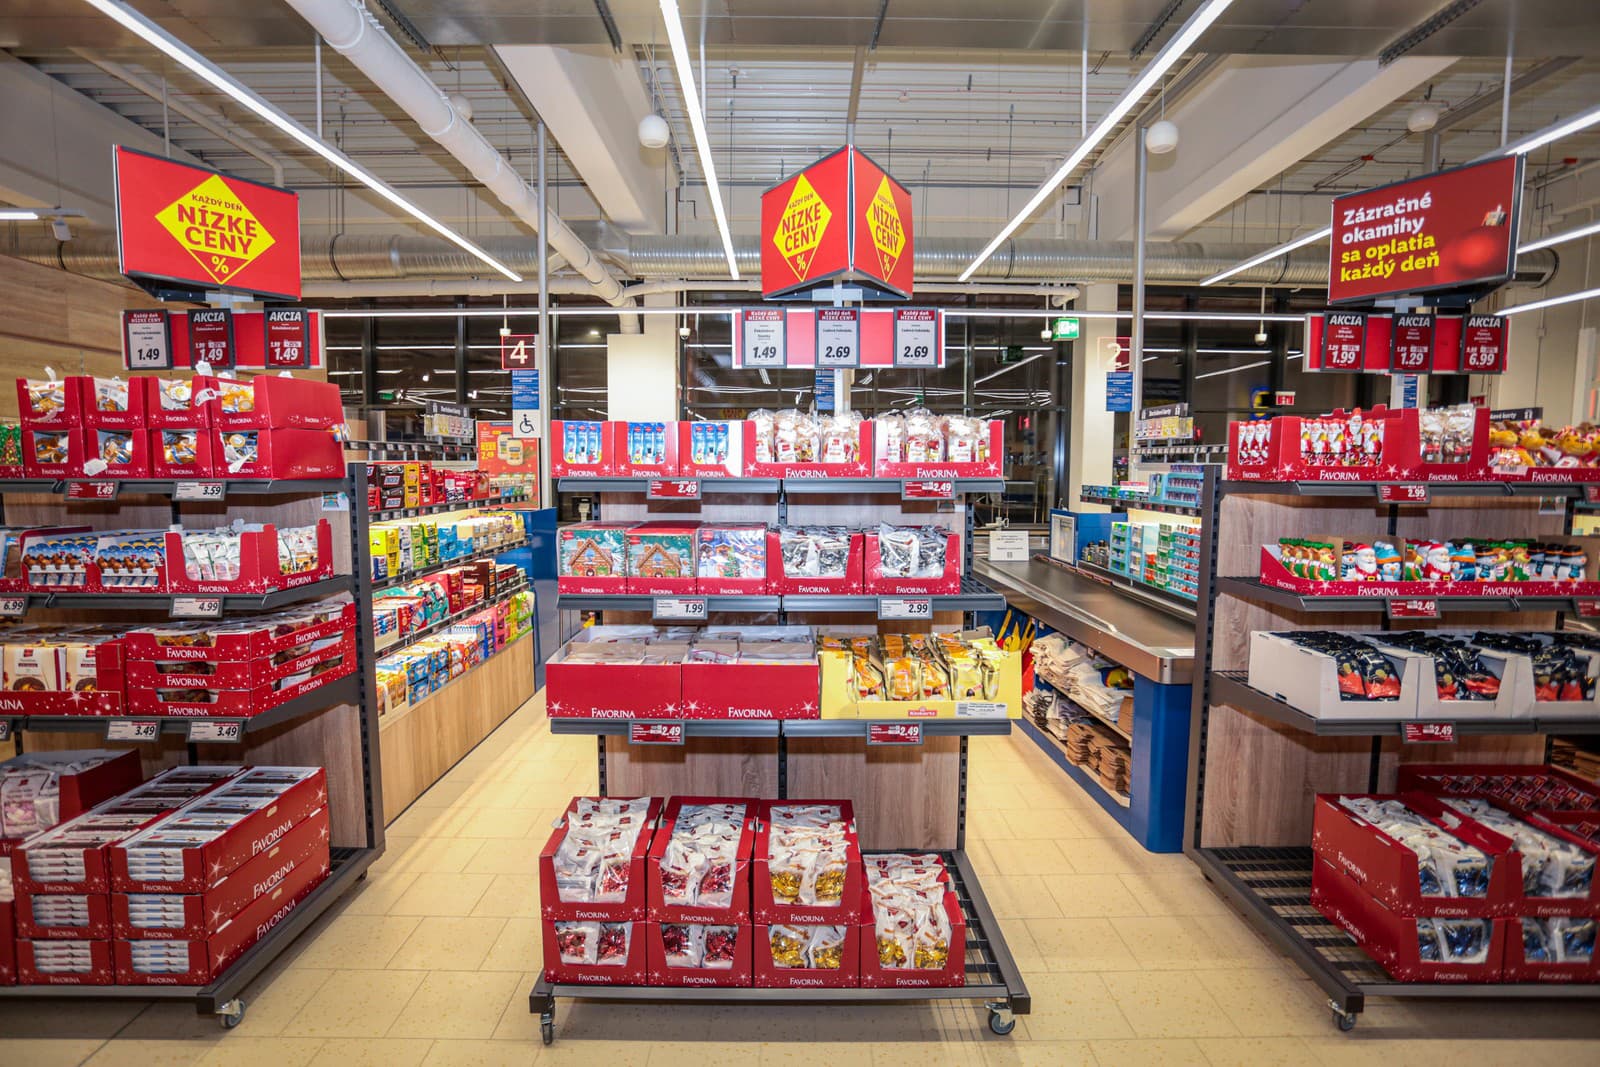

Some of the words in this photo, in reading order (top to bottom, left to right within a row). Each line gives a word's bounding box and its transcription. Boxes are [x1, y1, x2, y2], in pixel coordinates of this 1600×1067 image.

[192, 193, 222, 206] KAŽDÝ
[224, 200, 242, 212] DEŇ
[1343, 192, 1432, 226] Zázračné
[177, 204, 258, 238] NÍZKE
[782, 202, 822, 236] NÍZKE
[872, 203, 900, 236] NÍZKE
[1342, 216, 1424, 244] okamihy
[185, 227, 252, 254] CENY
[785, 223, 818, 252] CENY
[876, 226, 898, 254] CENY
[1341, 250, 1361, 264] sa
[1366, 232, 1436, 258] oplatia
[211, 255, 229, 274] %
[1340, 260, 1396, 282] každý
[1400, 252, 1440, 272] deň
[194, 312, 225, 322] AKCIA
[270, 312, 302, 322] AKCIA
[1330, 315, 1362, 326] AKCIA
[1398, 316, 1430, 327] AKCIA
[1468, 318, 1500, 328] AKCIA
[138, 348, 160, 360] 1.49
[200, 348, 223, 361] 1.49
[275, 348, 298, 360] 1.49
[510, 340, 528, 364] 4
[753, 346, 776, 358] 1.49
[825, 346, 850, 358] 2.69
[904, 346, 928, 358] 2.69
[1106, 342, 1122, 366] 2
[1332, 352, 1356, 364] 1.99
[1400, 353, 1424, 366] 1.29
[1469, 353, 1494, 366] 6.99
[786, 468, 828, 478] FAVORINA
[917, 468, 958, 478] FAVORINA
[1320, 470, 1360, 480] FAVORINA
[1532, 472, 1572, 482] FAVORINA
[202, 486, 221, 496] 3.59
[678, 484, 696, 494] 2.49
[934, 482, 952, 492] 2.49
[1408, 488, 1425, 498] 2.99
[287, 575, 312, 587] FAVORINA
[1358, 586, 1398, 596] FAVORINA
[1482, 585, 1522, 596] FAVORINA
[4, 602, 23, 610] 6.99
[199, 602, 218, 611] 4.99
[685, 604, 703, 614] 1.99
[908, 604, 928, 613] 2.99
[1418, 601, 1435, 610] 2.49
[296, 630, 320, 644] FAVORINA
[166, 648, 208, 658] FAVORINA
[296, 655, 320, 670] FAVORINA
[166, 676, 208, 686] FAVORINA
[298, 678, 322, 694] FAVORINA
[168, 706, 208, 716] FAVORINA
[591, 708, 635, 718] FAVORINA
[728, 707, 772, 718] FAVORINA
[135, 726, 155, 736] 3.49
[217, 726, 236, 736] 3.49
[662, 726, 680, 736] 2.49
[900, 726, 918, 736] 2.49
[1434, 726, 1452, 735] 2.49
[252, 820, 293, 856] FAVORINA
[1337, 852, 1368, 882] FAVORINA
[253, 860, 294, 899] FAVORINA
[256, 900, 296, 941] FAVORINA
[680, 914, 714, 922] FAVORINA
[790, 914, 824, 922] FAVORINA
[1336, 910, 1366, 944] FAVORINA
[578, 974, 612, 982] FAVORINA
[682, 976, 716, 984] FAVORINA
[1434, 972, 1468, 980] FAVORINA
